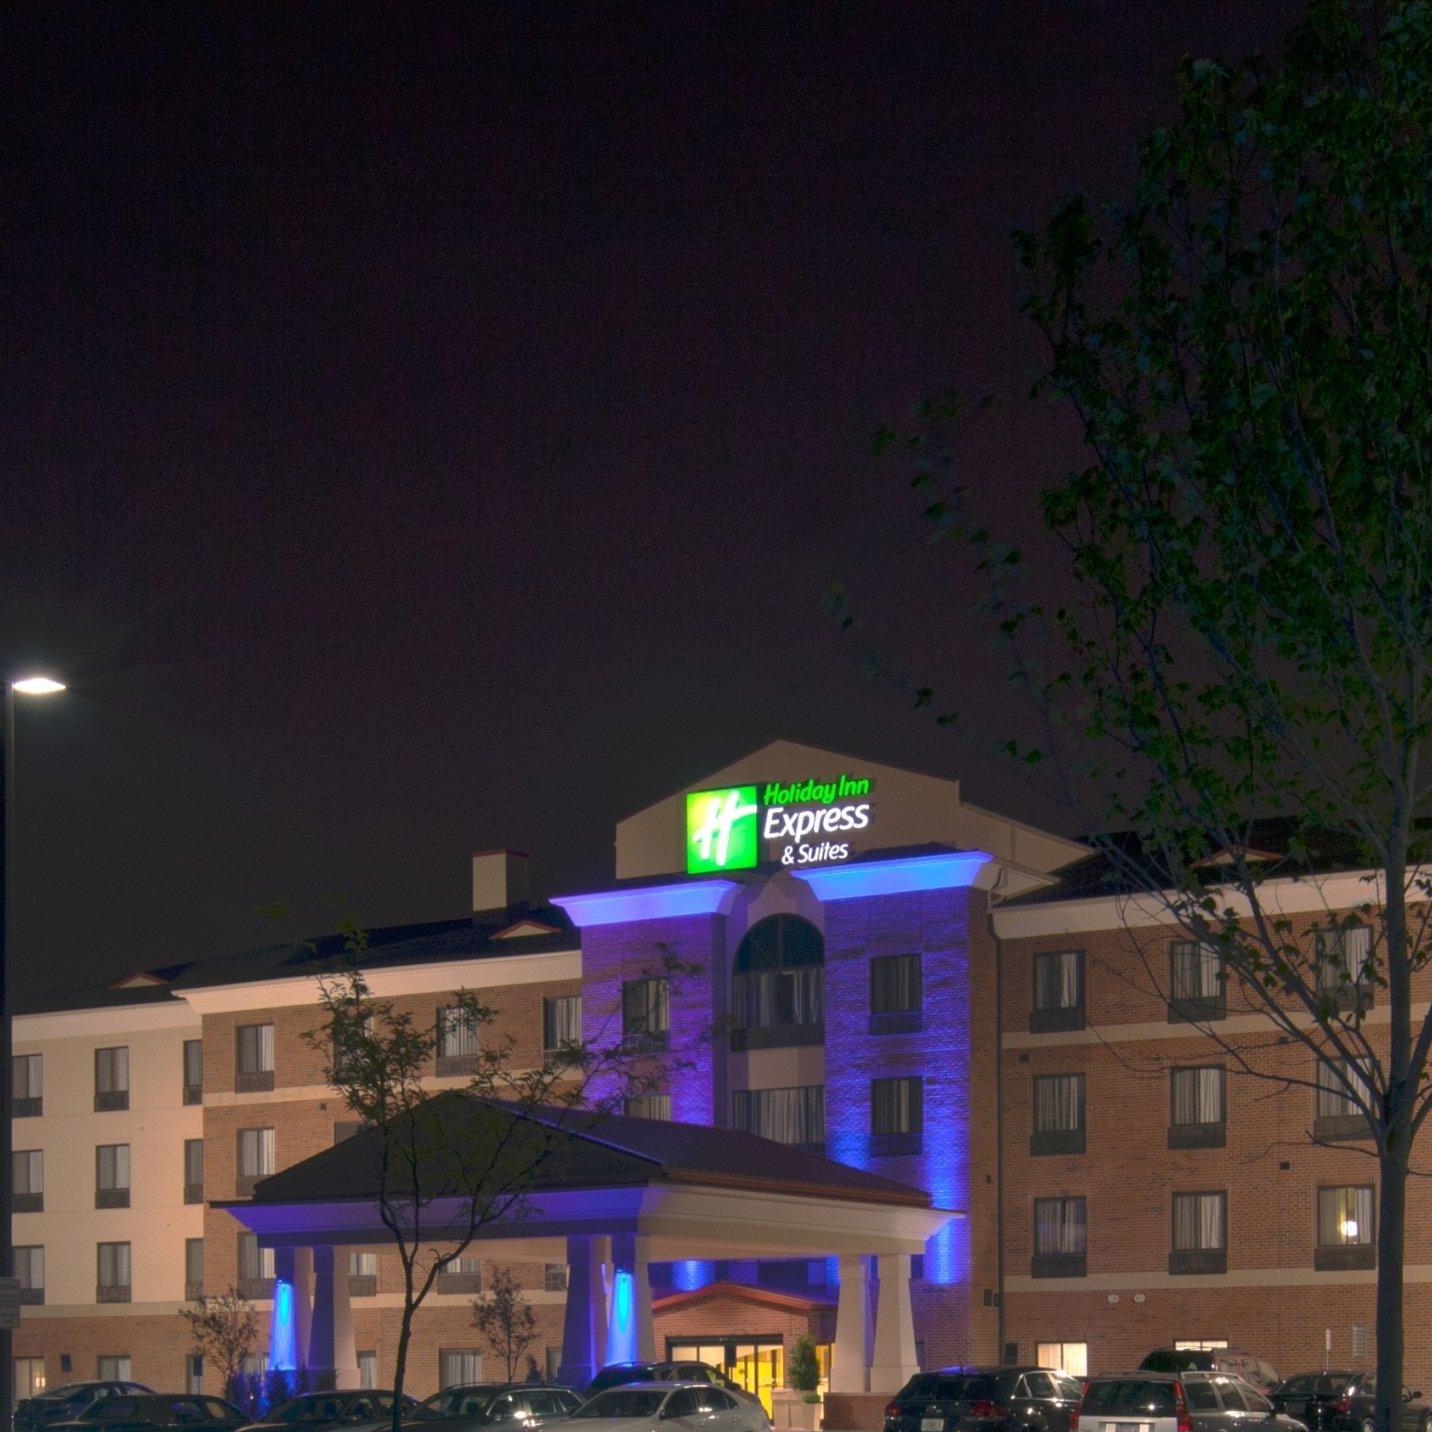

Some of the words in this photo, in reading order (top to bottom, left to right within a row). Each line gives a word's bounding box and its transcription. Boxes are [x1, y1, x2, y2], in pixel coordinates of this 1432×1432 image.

[764, 780, 836, 806] Holiday
[839, 775, 869, 797] Inn
[763, 803, 870, 843] Express
[781, 847, 795, 865] &
[798, 842, 849, 864] Suites
